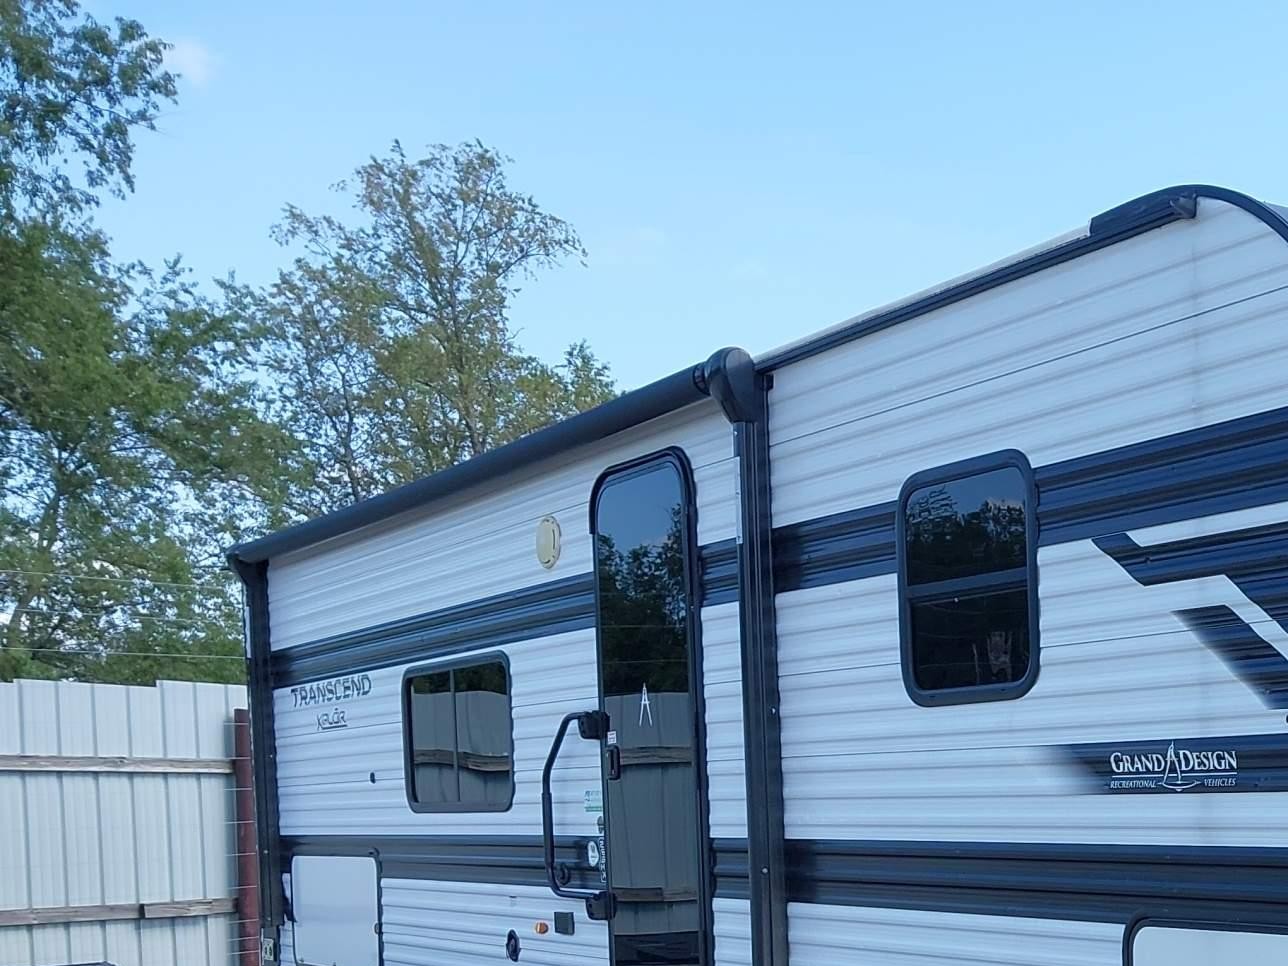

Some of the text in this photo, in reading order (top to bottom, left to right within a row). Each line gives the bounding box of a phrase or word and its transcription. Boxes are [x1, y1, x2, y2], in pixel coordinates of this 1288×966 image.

[291, 674, 372, 708] TRANSCEND
[1110, 778, 1237, 789] RECREATIONAL VEHICLES
